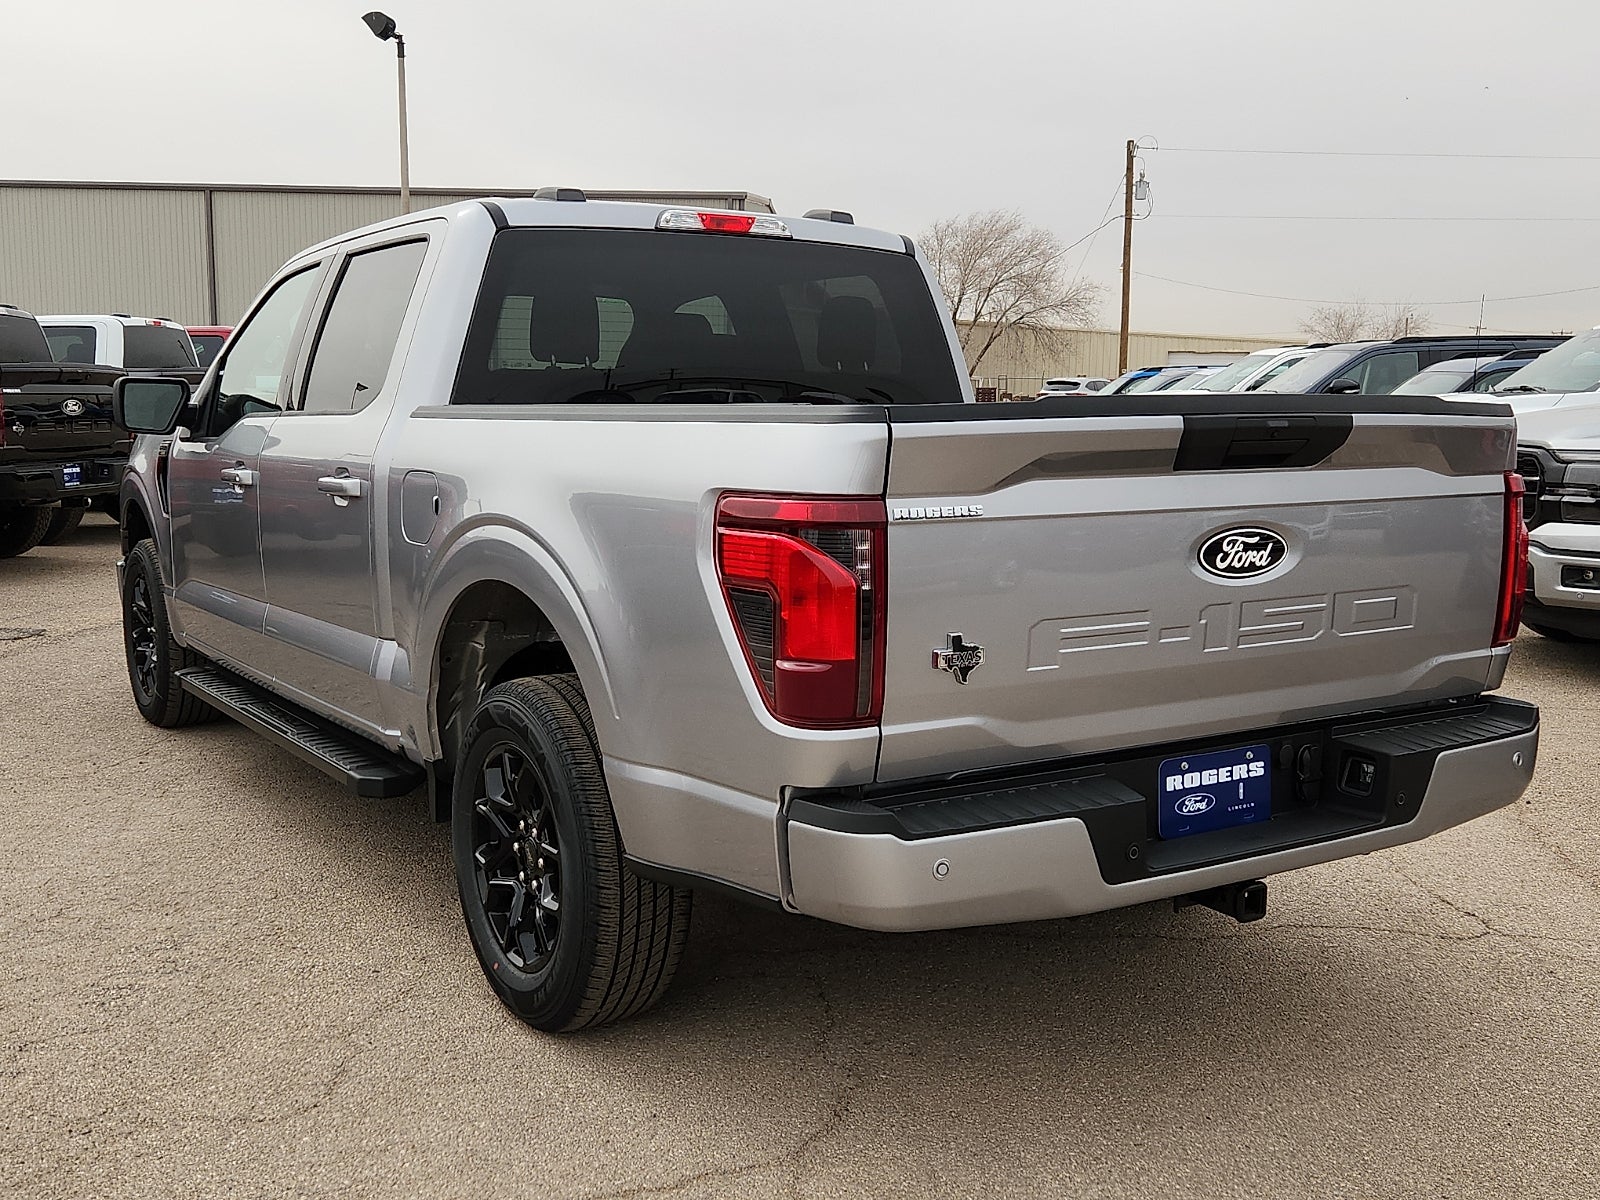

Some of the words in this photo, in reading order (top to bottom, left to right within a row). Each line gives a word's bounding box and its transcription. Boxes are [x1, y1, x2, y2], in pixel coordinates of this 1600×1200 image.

[893, 504, 983, 520] ROGERS
[1213, 532, 1275, 571] Ford
[1026, 585, 1418, 671] F-150
[942, 650, 982, 666] TEXAS
[1166, 761, 1265, 792] ROGERS
[1181, 795, 1209, 814] Ford
[1228, 802, 1255, 812] LINCOLN
